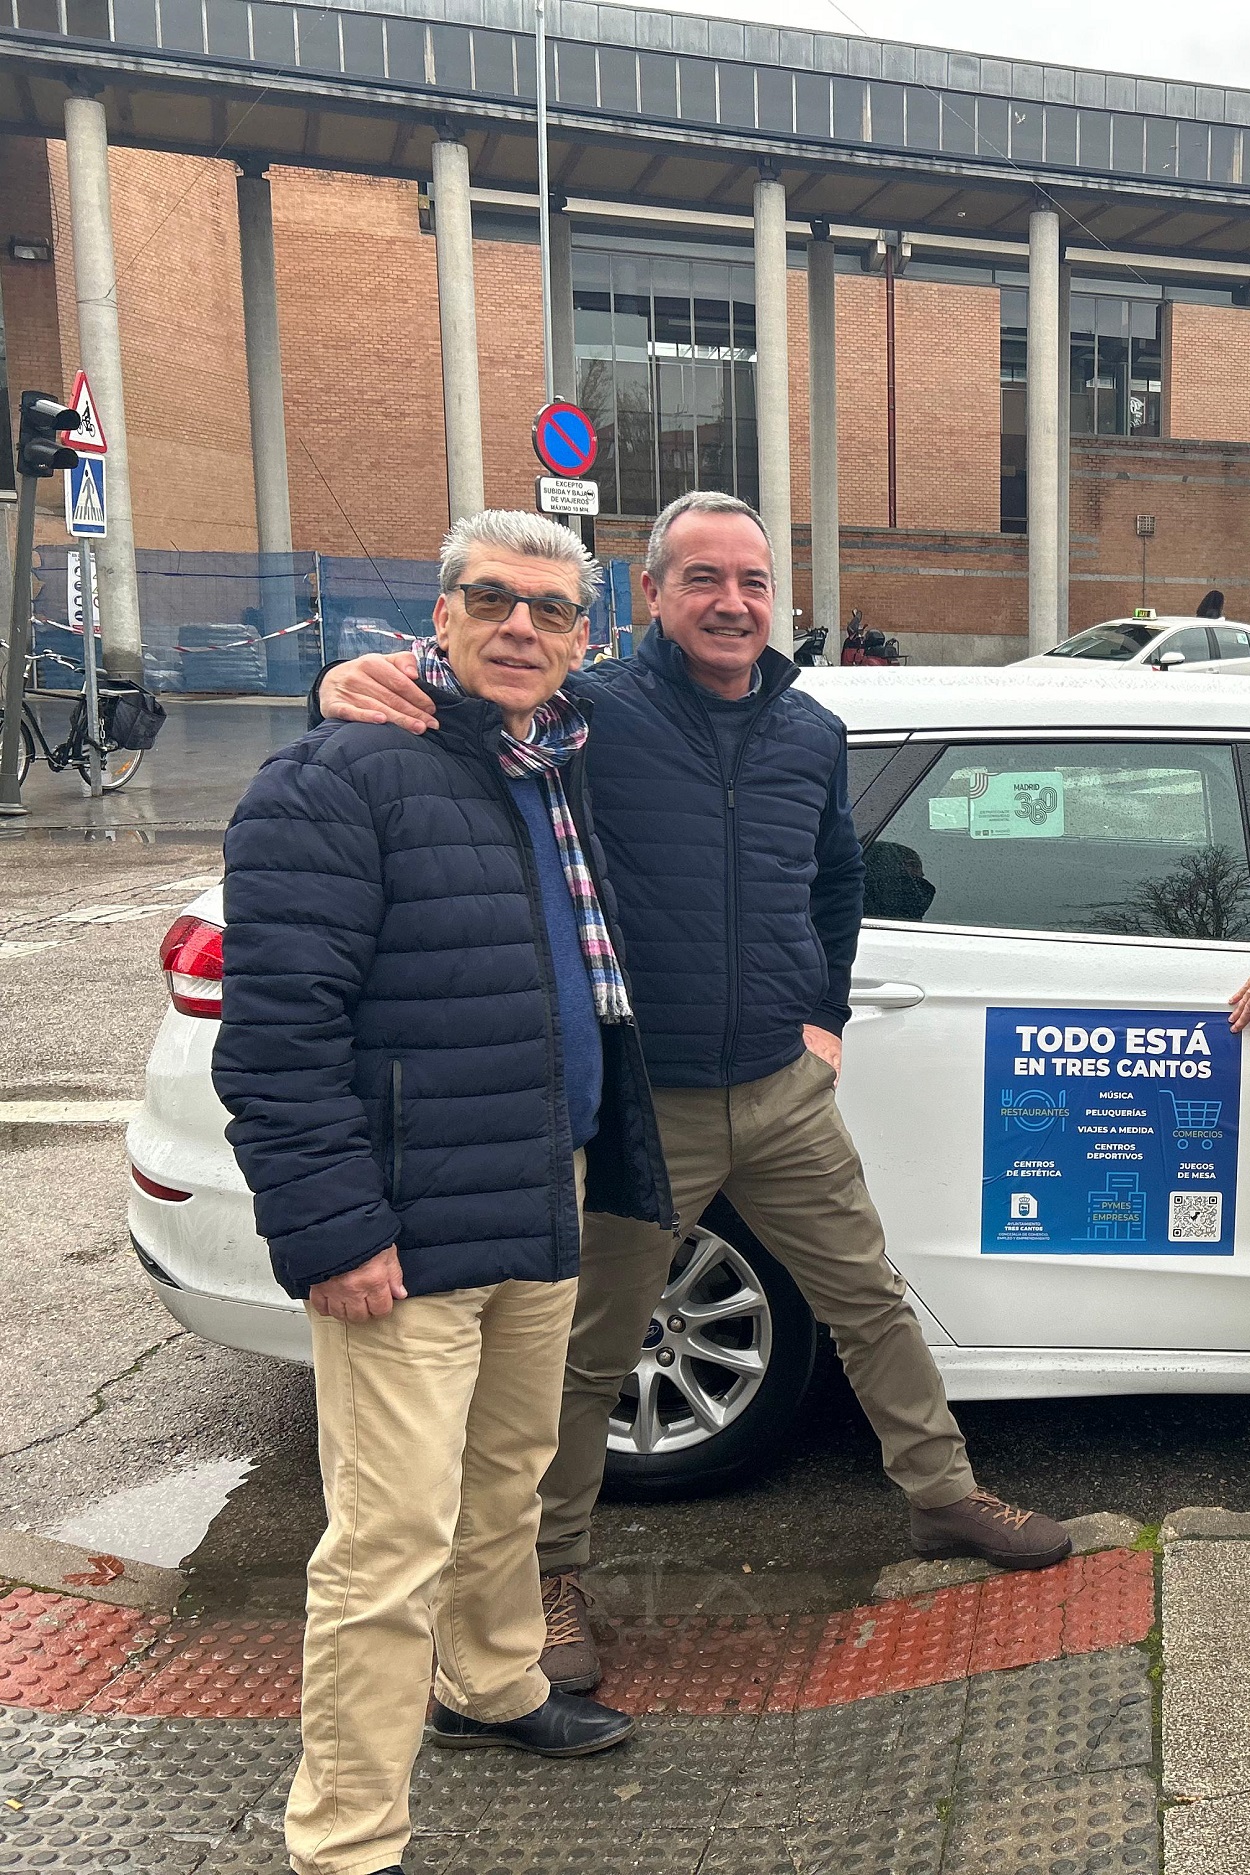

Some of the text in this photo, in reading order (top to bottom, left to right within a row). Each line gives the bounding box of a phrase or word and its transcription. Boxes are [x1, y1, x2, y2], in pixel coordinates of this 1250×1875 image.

[556, 480, 584, 489] EXCEPTO
[560, 497, 589, 505] VIAJEROS
[1014, 786, 1057, 825] 360
[1016, 1022, 1212, 1055] TODO ESTÁ
[1014, 1057, 1212, 1079] EN TRES CANTOS
[1100, 1090, 1134, 1100] MÚSICA
[1000, 1108, 1070, 1117] RESTAURANTES
[1086, 1108, 1147, 1117] PELUQUERÍAS
[1078, 1126, 1108, 1134] VIAJES
[1118, 1126, 1154, 1134] MEDIDA
[1172, 1130, 1223, 1139] COMERCIOS
[1094, 1143, 1136, 1151] CENTROS
[1086, 1152, 1144, 1160] DEPORTIVOS
[1013, 1160, 1055, 1168] CENTROS
[1180, 1162, 1214, 1170] JUEGOS
[1020, 1168, 1062, 1178] ESTÉTICA
[1102, 1202, 1132, 1210] PYMES
[1092, 1213, 1140, 1222] EMPRESAS
